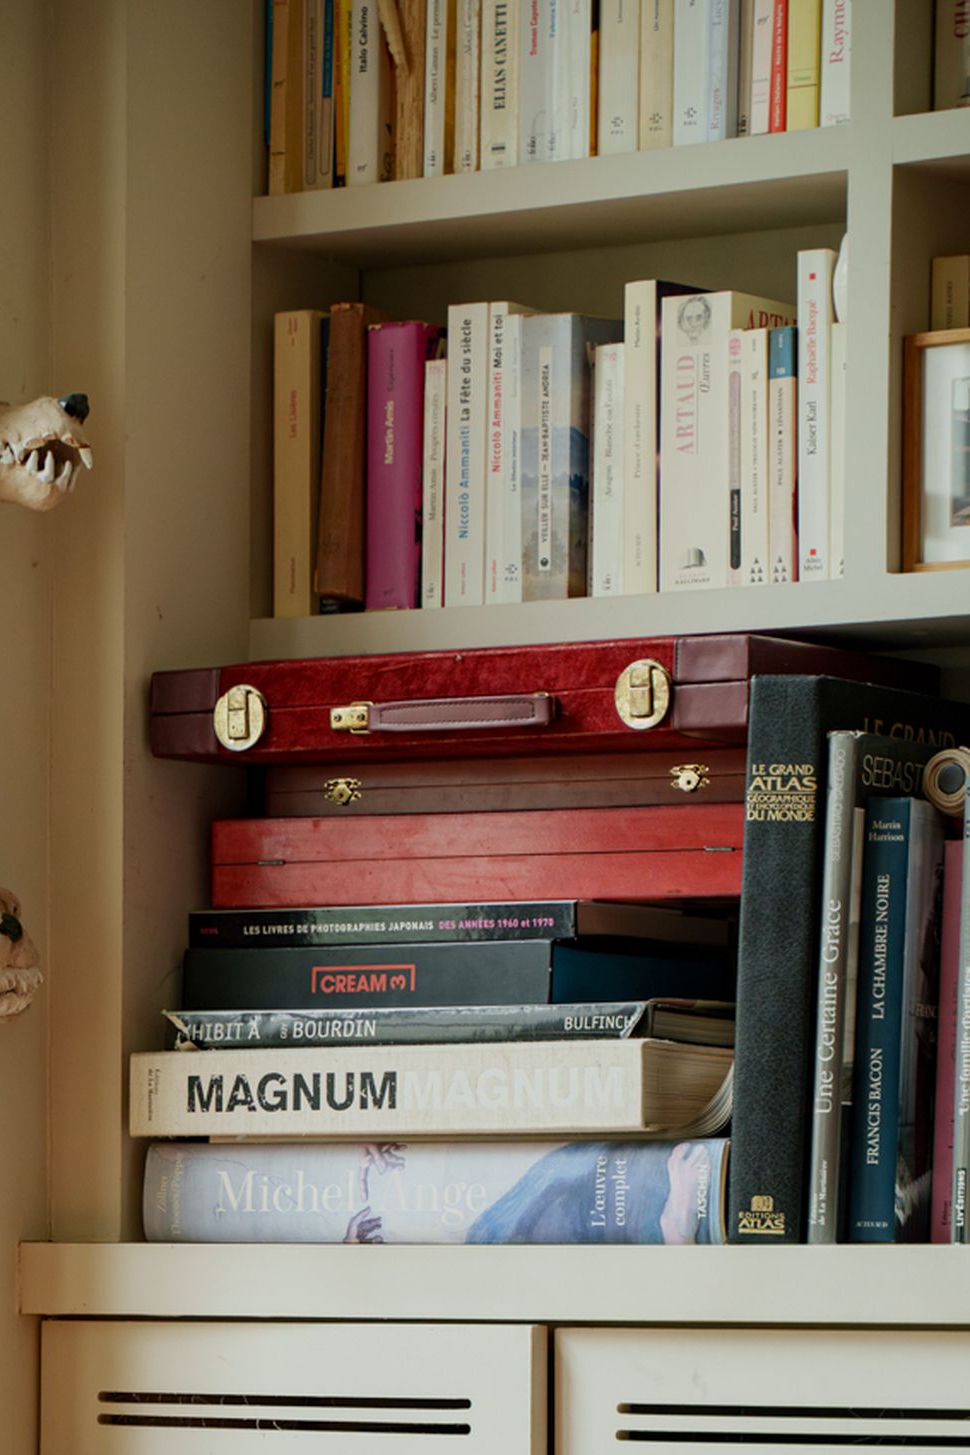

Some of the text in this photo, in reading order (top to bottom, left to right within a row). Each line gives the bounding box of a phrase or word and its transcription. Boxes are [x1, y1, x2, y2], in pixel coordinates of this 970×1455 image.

[359, 6, 368, 73] Italo Calvino
[493, 3, 508, 111] ELIAS CANETTI
[529, 28, 537, 56] Truman
[806, 300, 819, 335] Bacqué
[491, 314, 504, 473] Niccolò Ammaniti Moi et toi
[699, 352, 711, 394] Œuvres
[676, 355, 696, 455] ARTAUD
[288, 423, 297, 438] Les
[384, 401, 395, 464] Martin Amis
[458, 319, 472, 539] Niccolò Ammaniti La Fête du siècle
[807, 401, 817, 455] Kaiser Karl
[541, 364, 550, 543] VEILLER SUR ELLE JEAN-BAPTISTE ANDREA
[748, 776, 818, 791] ATLAS
[752, 764, 814, 775] LE GRAND
[861, 754, 924, 792] SEBAST
[746, 810, 815, 821] DU MONDE
[872, 819, 901, 830] Martin
[868, 831, 905, 843] Harrison
[243, 926, 261, 936] LES
[262, 925, 294, 936] LIVRES
[297, 924, 308, 934] DE
[310, 922, 385, 934] PHOTOGRAPHIES
[388, 920, 434, 932] JAPONAIS
[438, 921, 456, 930] DES
[497, 918, 519, 928] 1960
[520, 919, 531, 928] et
[533, 917, 554, 927] 1970
[872, 874, 891, 1020] LA CHAMBRE NOIRE
[320, 974, 387, 993] CREAM
[563, 1015, 634, 1031] BULFINCH
[814, 899, 842, 1114] Une Certaine Grâce
[186, 1019, 260, 1041] XHIBIT A
[292, 1019, 377, 1039] BOURDIN
[187, 1066, 623, 1113] MAGNUM MAGNUM
[866, 1048, 883, 1165] FRANCIS BACON
[958, 1083, 970, 1116] Une
[216, 1168, 488, 1226] Michel Ange
[590, 1155, 608, 1228] L'œuvre
[611, 1157, 630, 1226] complet
[697, 1163, 708, 1219] TASCHEN
[738, 1218, 785, 1228] ATLAS
